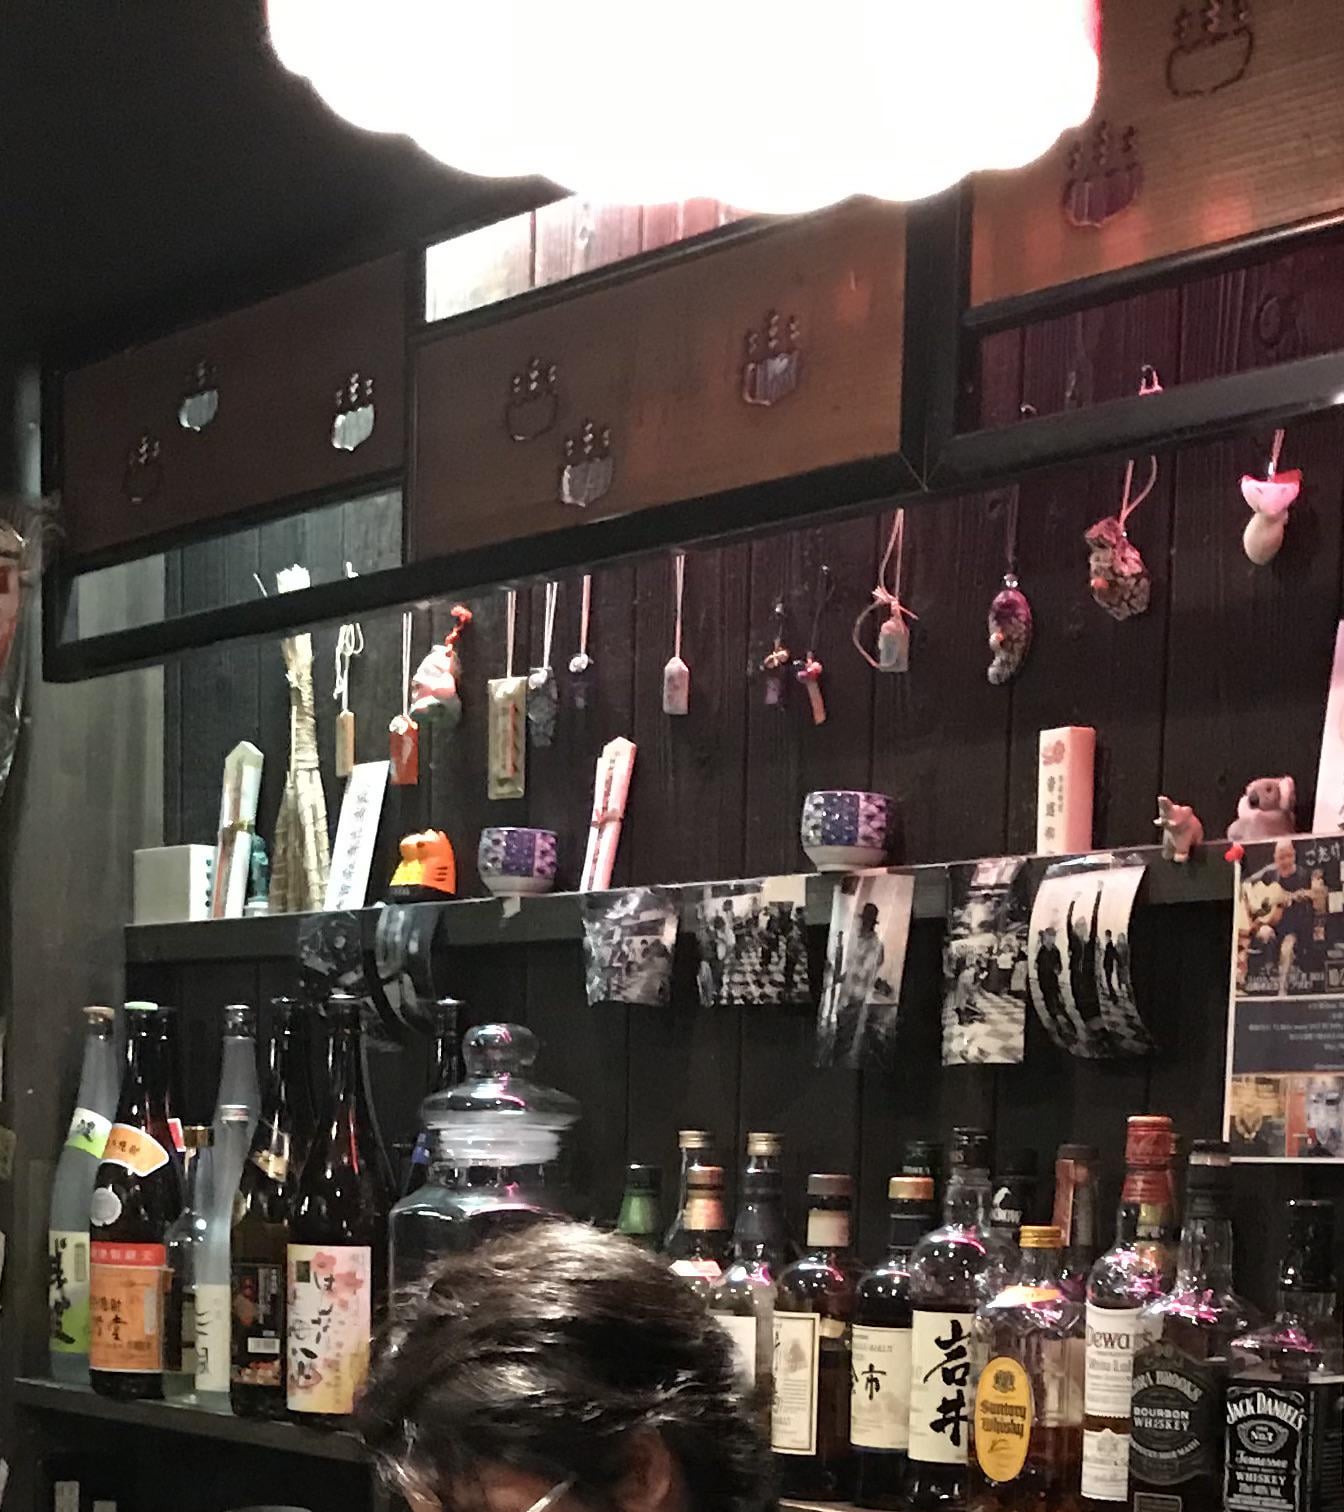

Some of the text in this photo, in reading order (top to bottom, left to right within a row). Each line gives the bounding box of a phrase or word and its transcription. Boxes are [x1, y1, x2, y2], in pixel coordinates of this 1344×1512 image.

[923, 1319, 971, 1446] 岩井
[979, 1400, 1027, 1421] Suntory
[1133, 1407, 1190, 1420] BOURBON
[1226, 1391, 1307, 1432] JACK DANIEL'S
[980, 1416, 1025, 1439] Whisky
[1133, 1416, 1190, 1431] WHISKEY
[1235, 1450, 1289, 1468] Tennessee
[1235, 1471, 1287, 1486] WHISKEY
